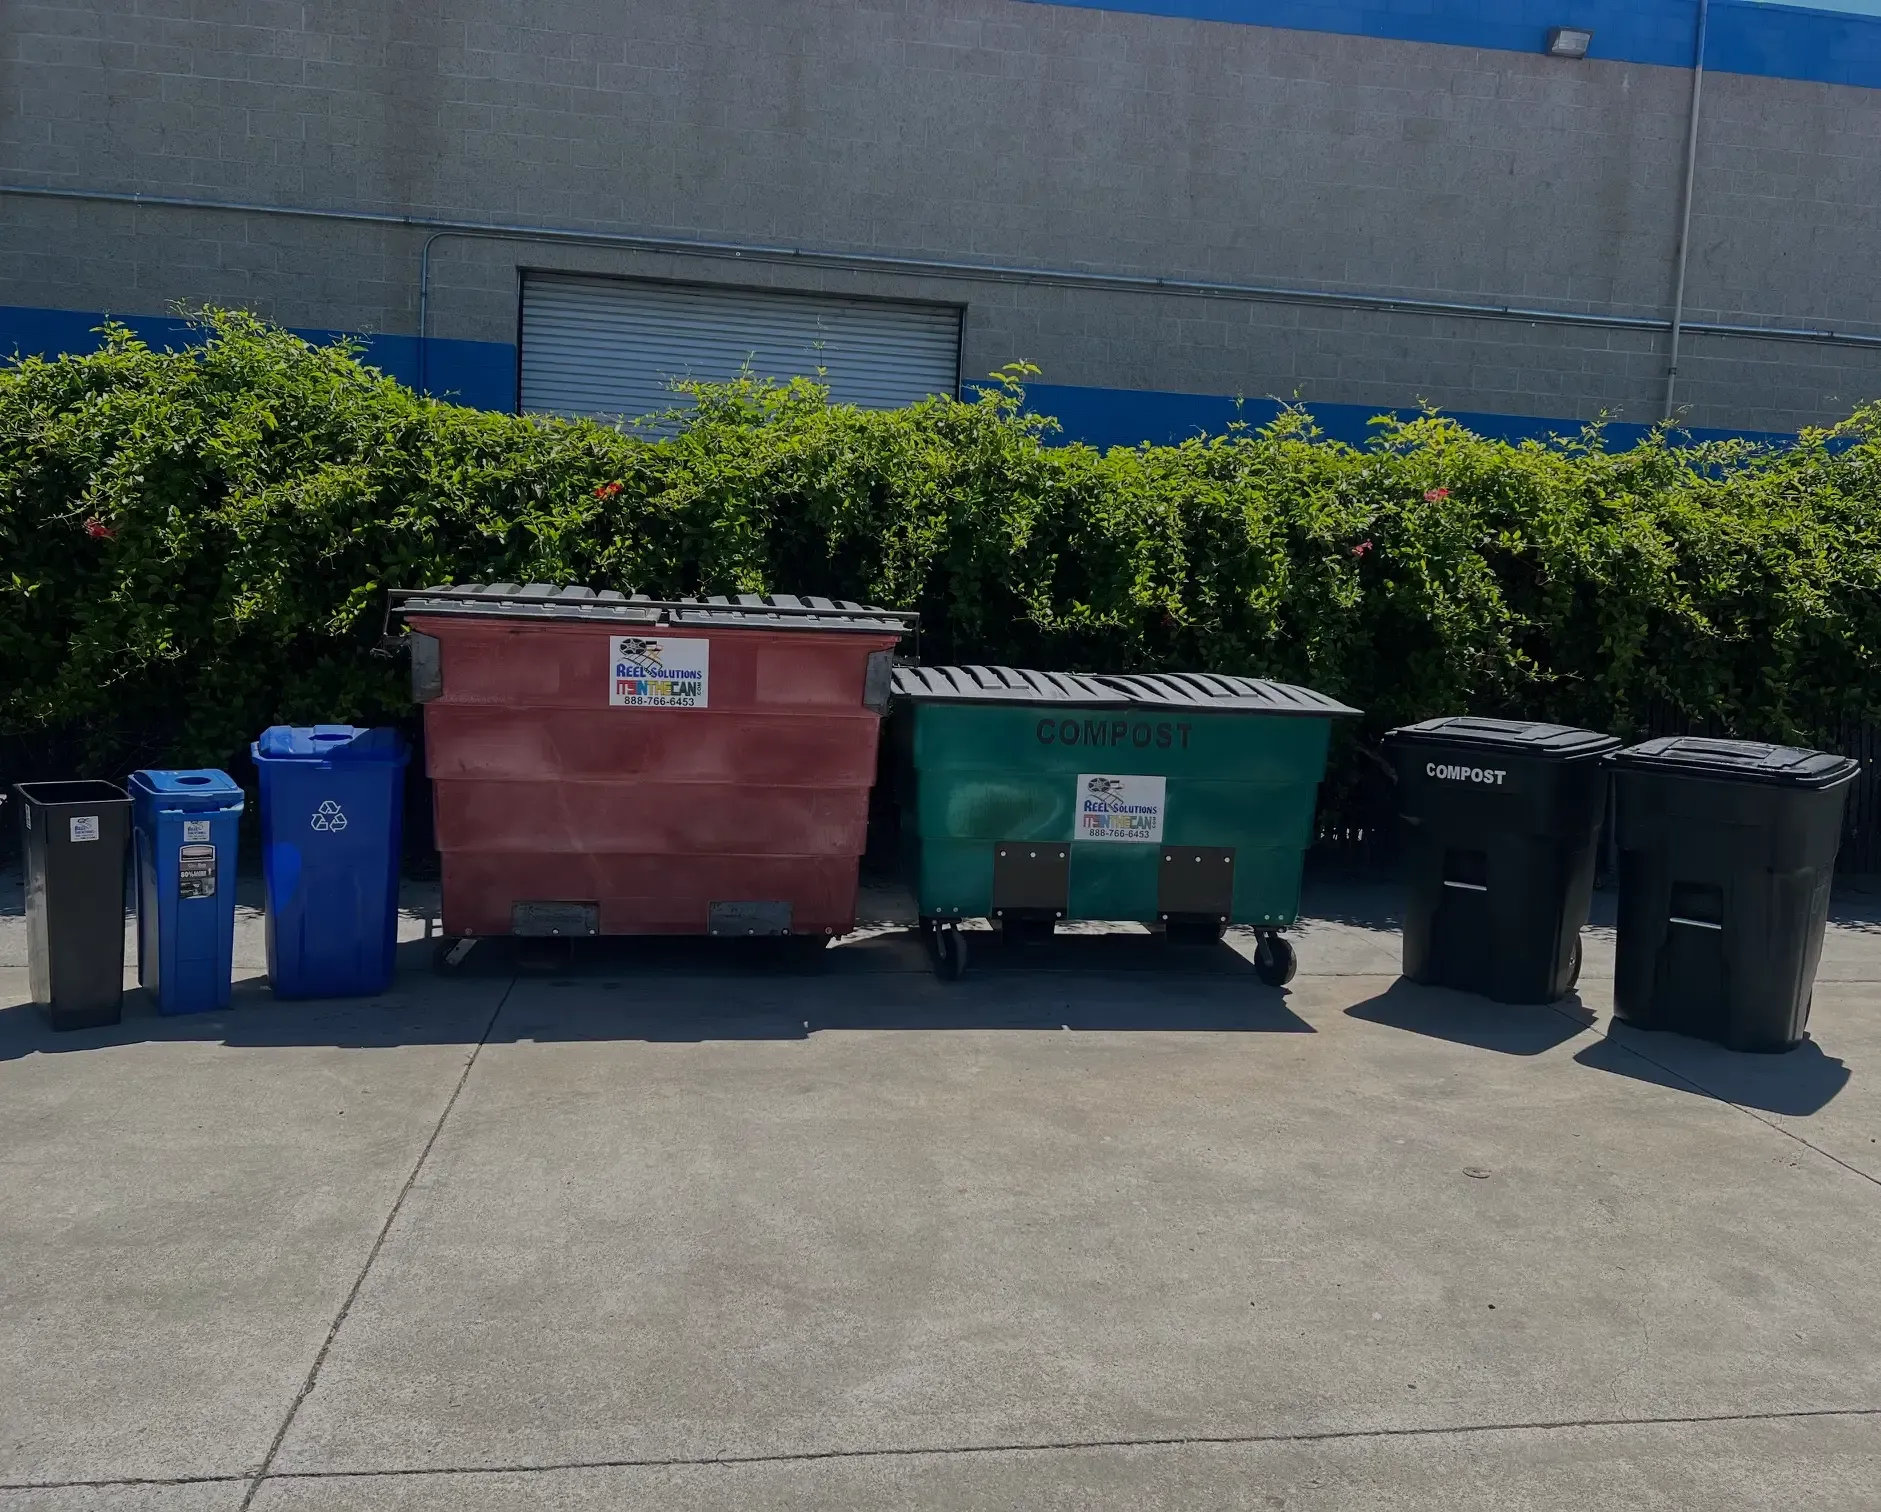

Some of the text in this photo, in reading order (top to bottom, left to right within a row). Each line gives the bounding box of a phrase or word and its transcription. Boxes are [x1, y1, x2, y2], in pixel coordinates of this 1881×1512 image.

[616, 663, 703, 680] REEL SOLUTIONS
[624, 696, 695, 706] 888-766-6453
[1036, 718, 1193, 749] COMPOST
[1426, 762, 1507, 785] COMPOST
[1083, 800, 1158, 815] REEL SOLUTIONS
[1089, 829, 1150, 839] 888-766-6453
